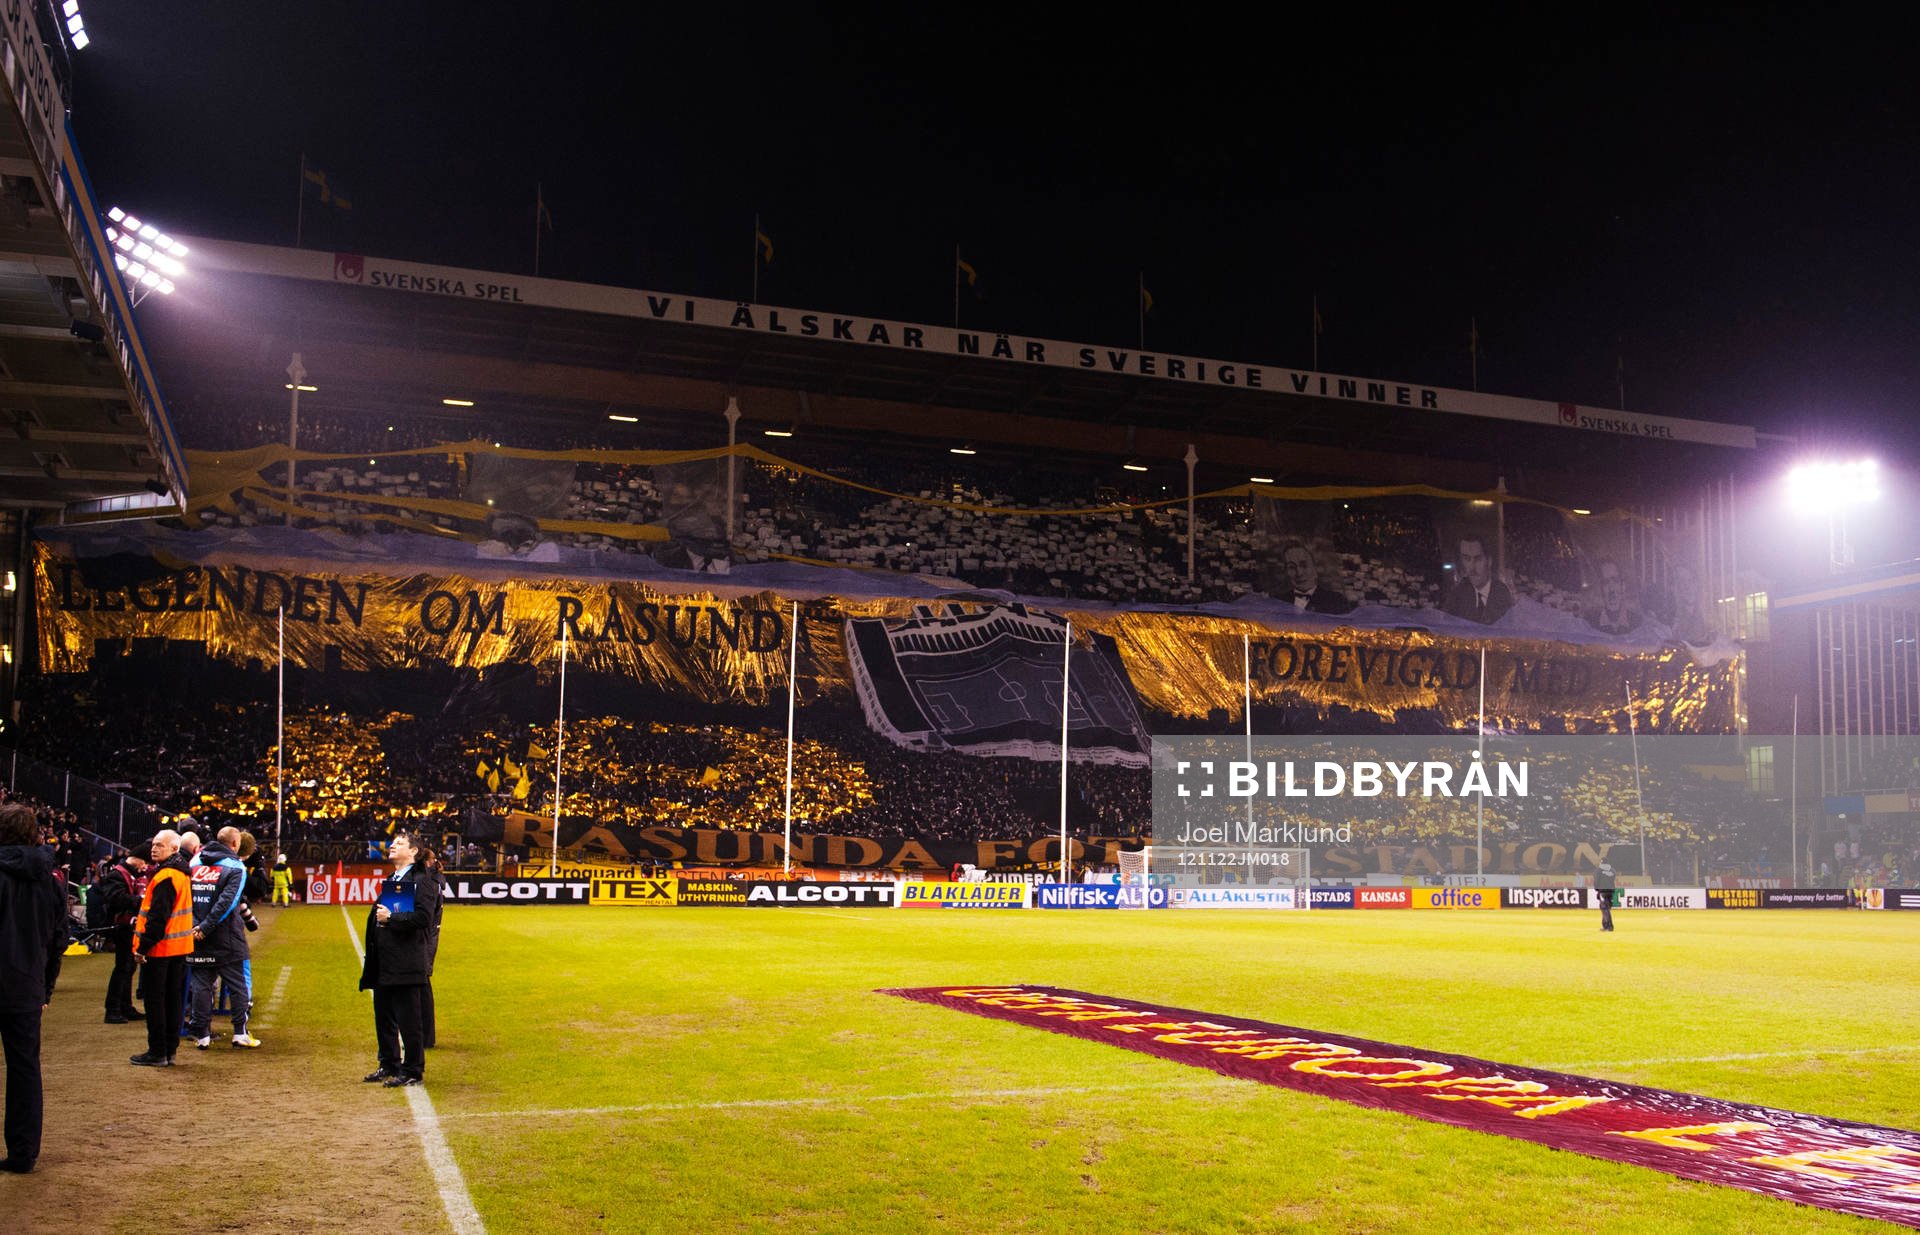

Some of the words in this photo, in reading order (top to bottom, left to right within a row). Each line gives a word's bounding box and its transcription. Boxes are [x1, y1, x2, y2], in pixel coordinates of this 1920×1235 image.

[23, 20, 56, 140] FOTBOLL
[370, 271, 467, 296] SVENSKA
[474, 282, 524, 302] SPEL
[647, 296, 694, 322] VI
[730, 302, 924, 349] ÄLSKAR
[958, 334, 1046, 363] NÄR
[1079, 348, 1262, 388] SVERIGE
[1291, 373, 1438, 409] VINNER
[1580, 415, 1640, 434] SVENSKA
[1643, 424, 1675, 439] SPEL
[58, 560, 372, 628] LEGENDEN
[420, 590, 508, 636] OM
[1249, 634, 1479, 692] FÖREVIGAD
[191, 865, 221, 882] Lete
[549, 866, 635, 879] Proguard
[336, 876, 388, 902] TAK
[592, 879, 673, 899] ITEX
[686, 883, 738, 892] MASKIN-
[747, 885, 895, 902] ALCOTT
[905, 883, 1021, 901] BLÅKLÄDER
[1708, 890, 1757, 899] WESTERN
[678, 892, 747, 903] UTHYRNING
[1297, 890, 1352, 903] FISTADS
[1360, 891, 1406, 903] KANSAS
[1430, 888, 1483, 906] office
[1508, 887, 1580, 908] Inspecta
[1627, 895, 1690, 908] EMBALLAGE
[1723, 898, 1757, 907] UNION
[1769, 893, 1793, 903] moving
[1793, 893, 1815, 903] money
[1815, 892, 1825, 902] for
[1826, 893, 1846, 902] better
